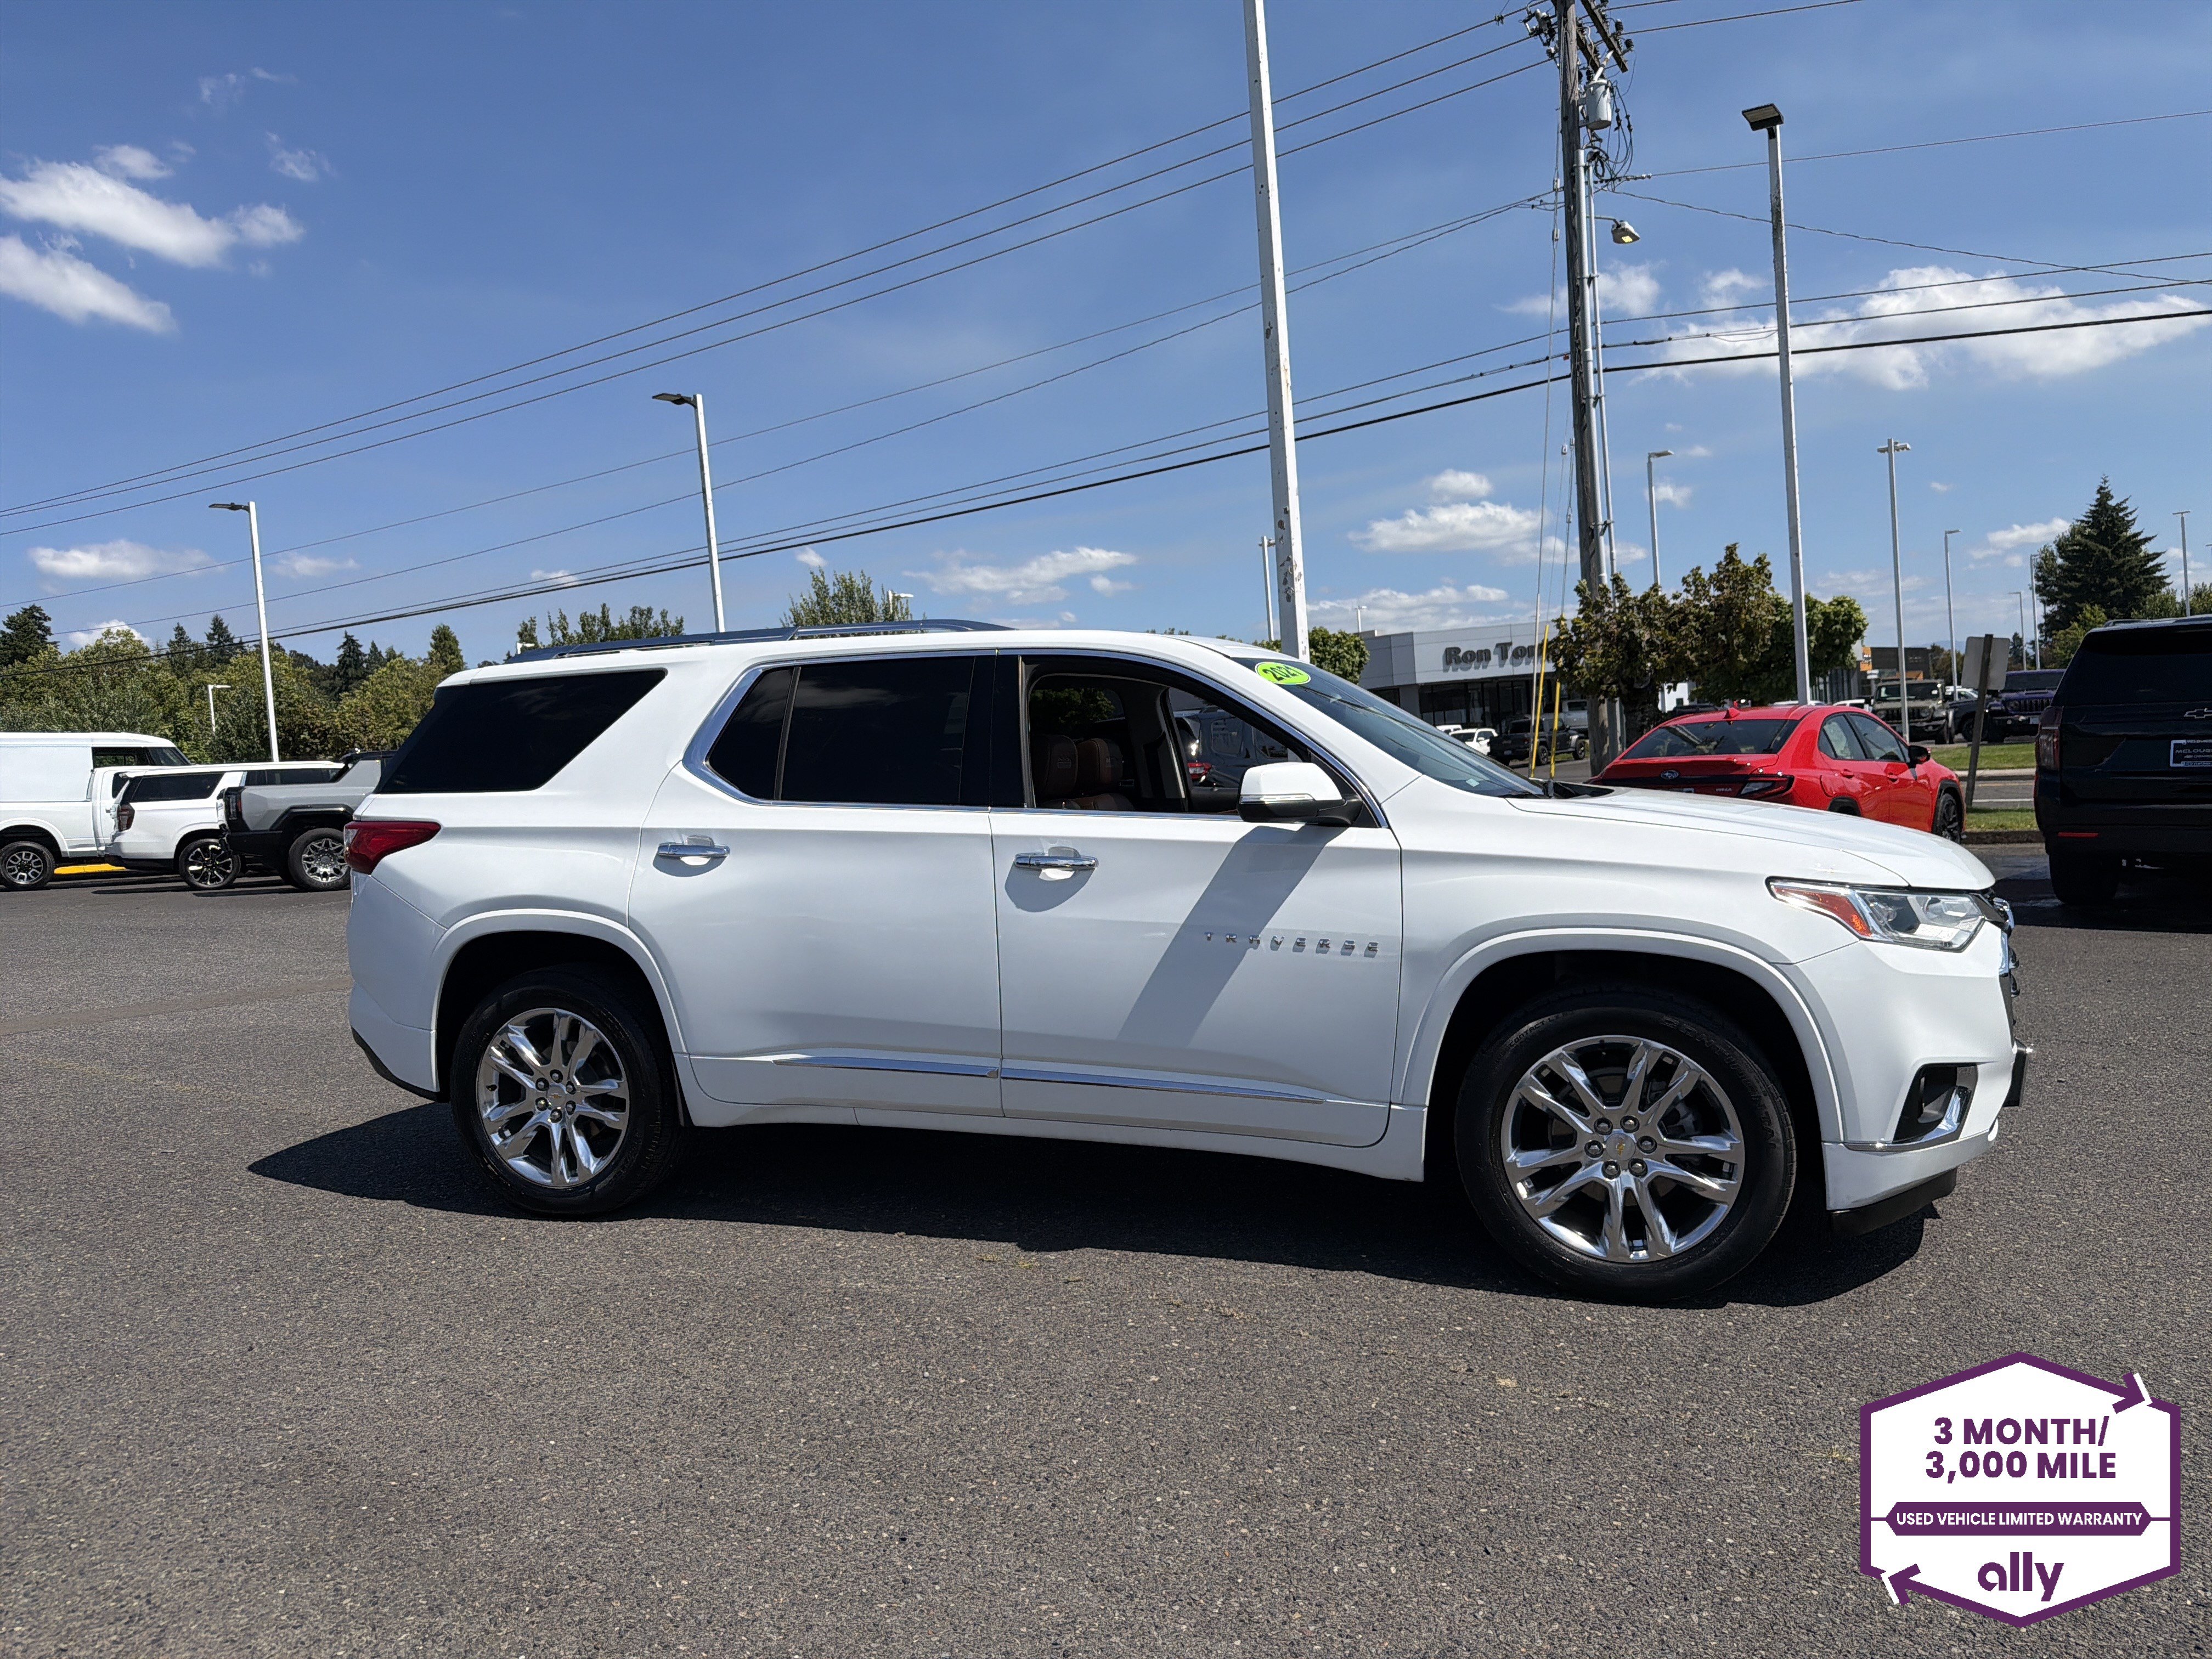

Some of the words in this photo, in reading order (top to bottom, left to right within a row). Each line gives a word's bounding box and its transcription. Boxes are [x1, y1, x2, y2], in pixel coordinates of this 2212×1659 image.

[1444, 647, 1491, 665] Ron
[1496, 641, 1543, 661] Ton
[1262, 665, 1304, 681] 2021
[1205, 932, 1379, 952] TRAVERSE
